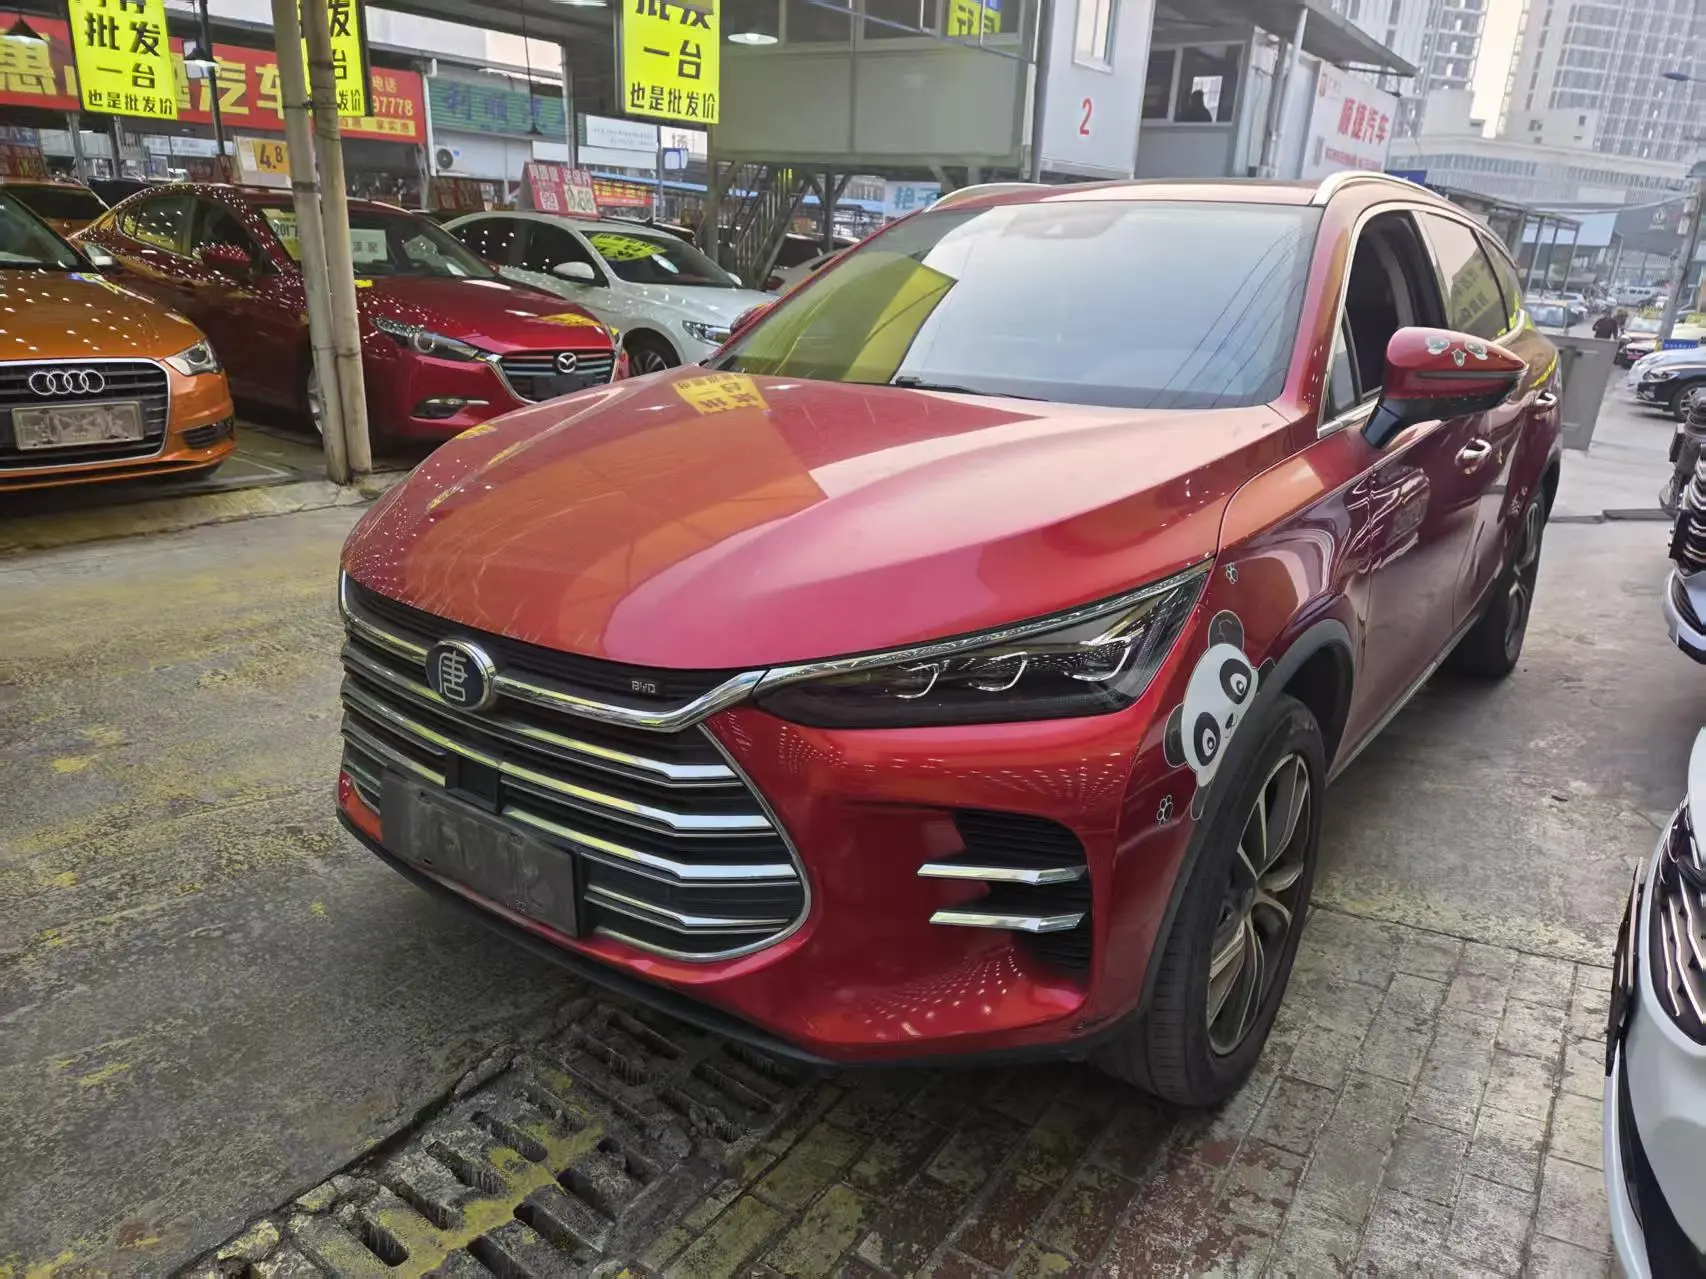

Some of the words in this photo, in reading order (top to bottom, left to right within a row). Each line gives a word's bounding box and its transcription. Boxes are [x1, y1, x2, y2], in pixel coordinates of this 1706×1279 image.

[84, 12, 161, 57] 批发
[96, 63, 155, 89] 一台
[643, 40, 702, 80] 一台
[87, 89, 173, 115] 也是批发价
[630, 81, 716, 120] 也是批发价
[1079, 98, 1093, 136] 2
[631, 680, 657, 695] BYD
